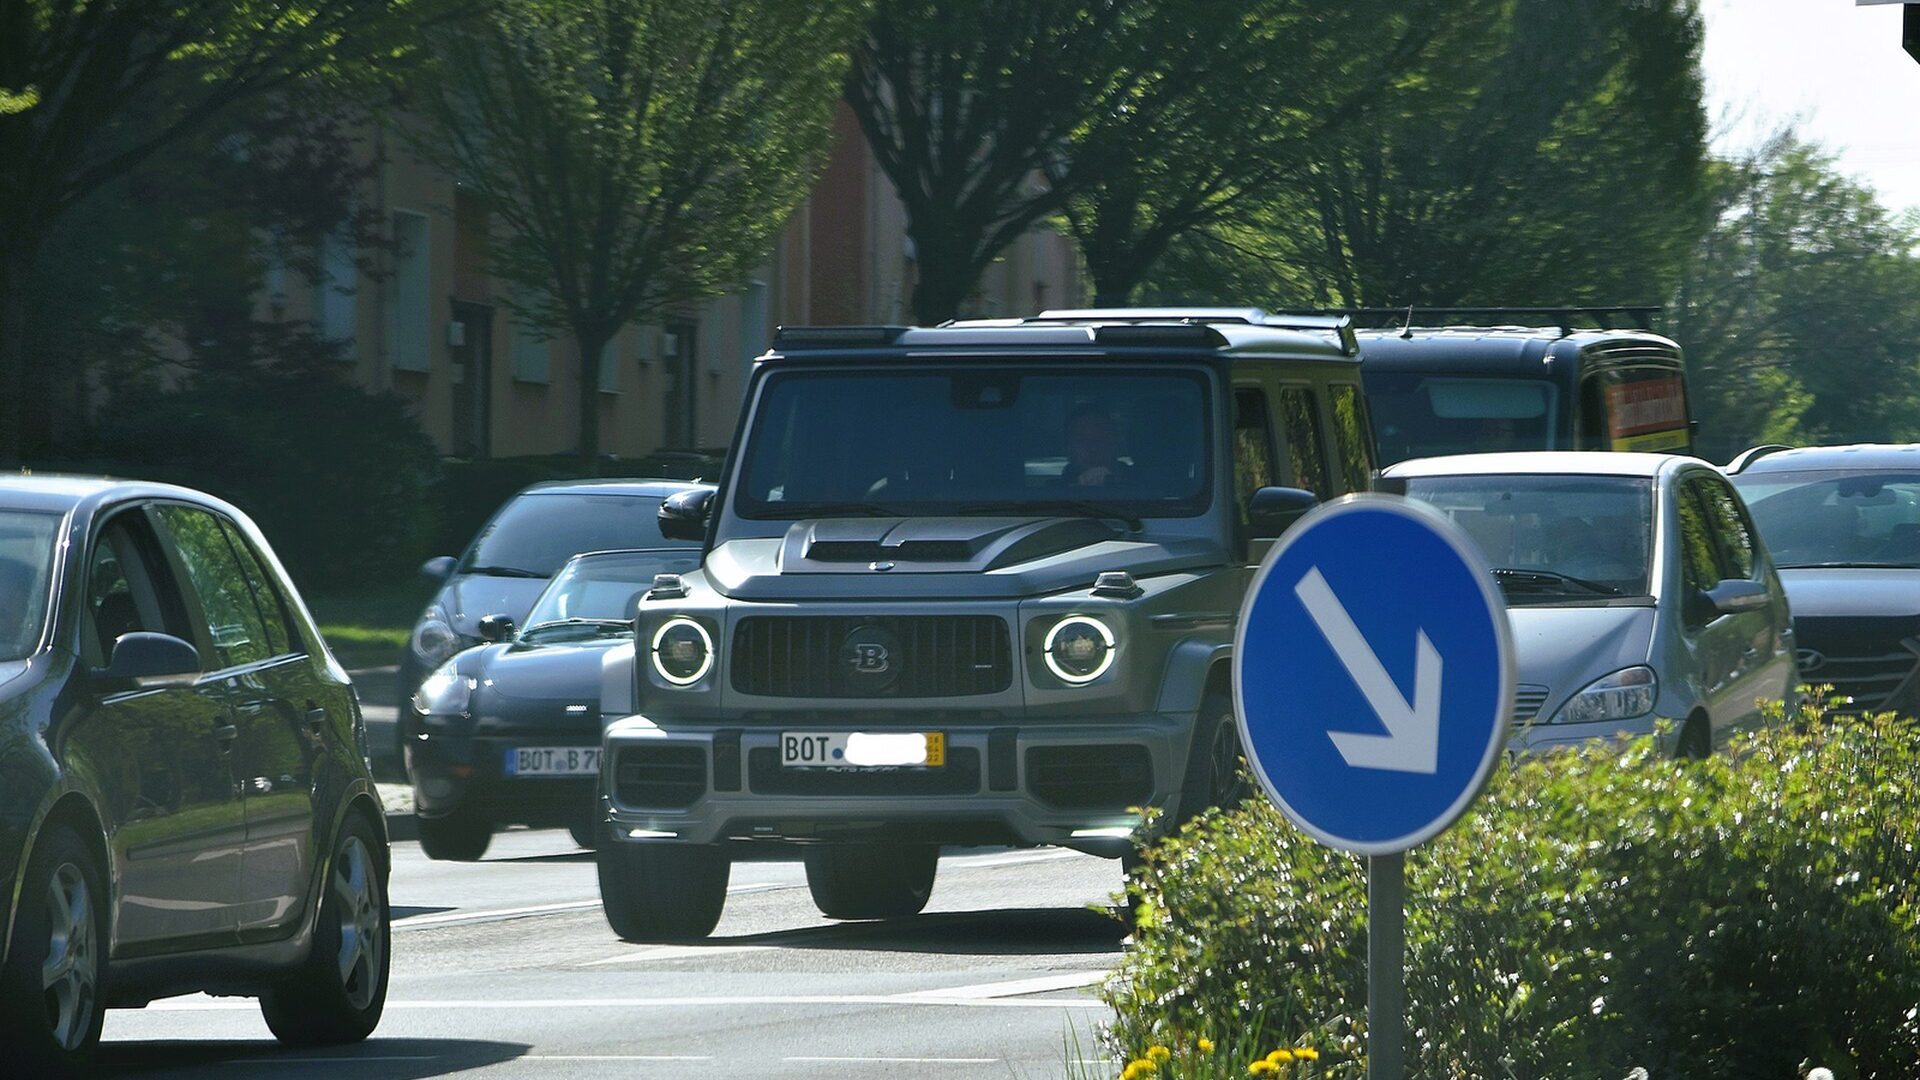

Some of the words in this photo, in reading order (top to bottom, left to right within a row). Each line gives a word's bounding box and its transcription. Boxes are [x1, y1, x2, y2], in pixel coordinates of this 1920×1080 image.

[520, 751, 554, 770] BOT
[567, 750, 579, 770] B
[785, 737, 829, 761] BOT
